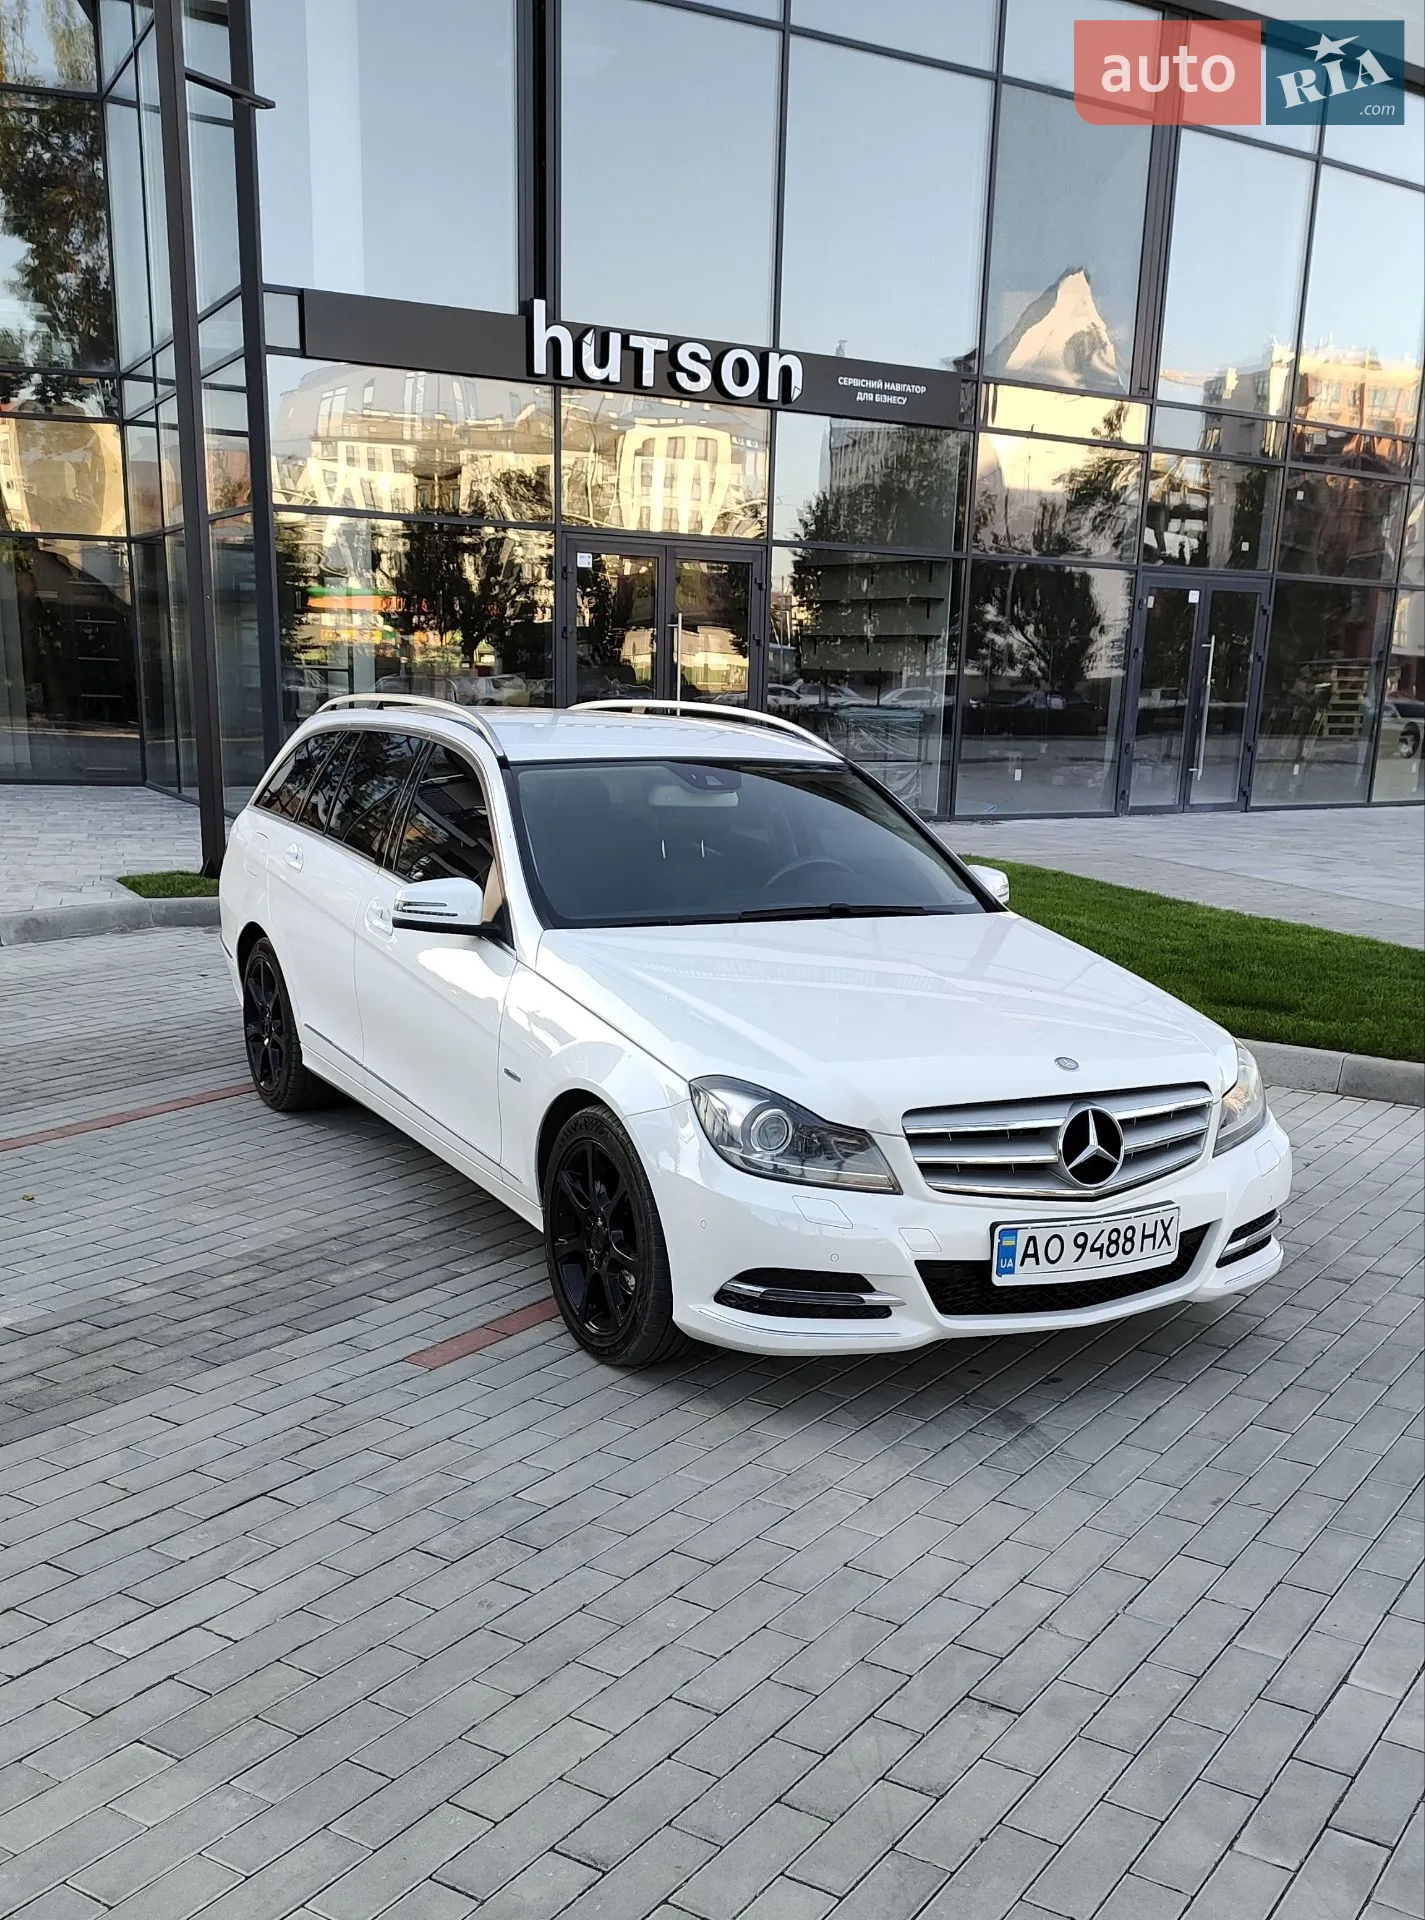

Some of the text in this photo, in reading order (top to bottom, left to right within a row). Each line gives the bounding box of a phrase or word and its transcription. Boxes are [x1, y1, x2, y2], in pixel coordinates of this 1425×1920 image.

[838, 376, 927, 394] СЕРВІСНИЙ НАВІГАТОР
[856, 391, 908, 405] ДЛЯ БІЗНЕСУ
[1020, 1234, 1065, 1267] AO
[1073, 1225, 1136, 1263] 9488
[1000, 1258, 1014, 1269] UA
